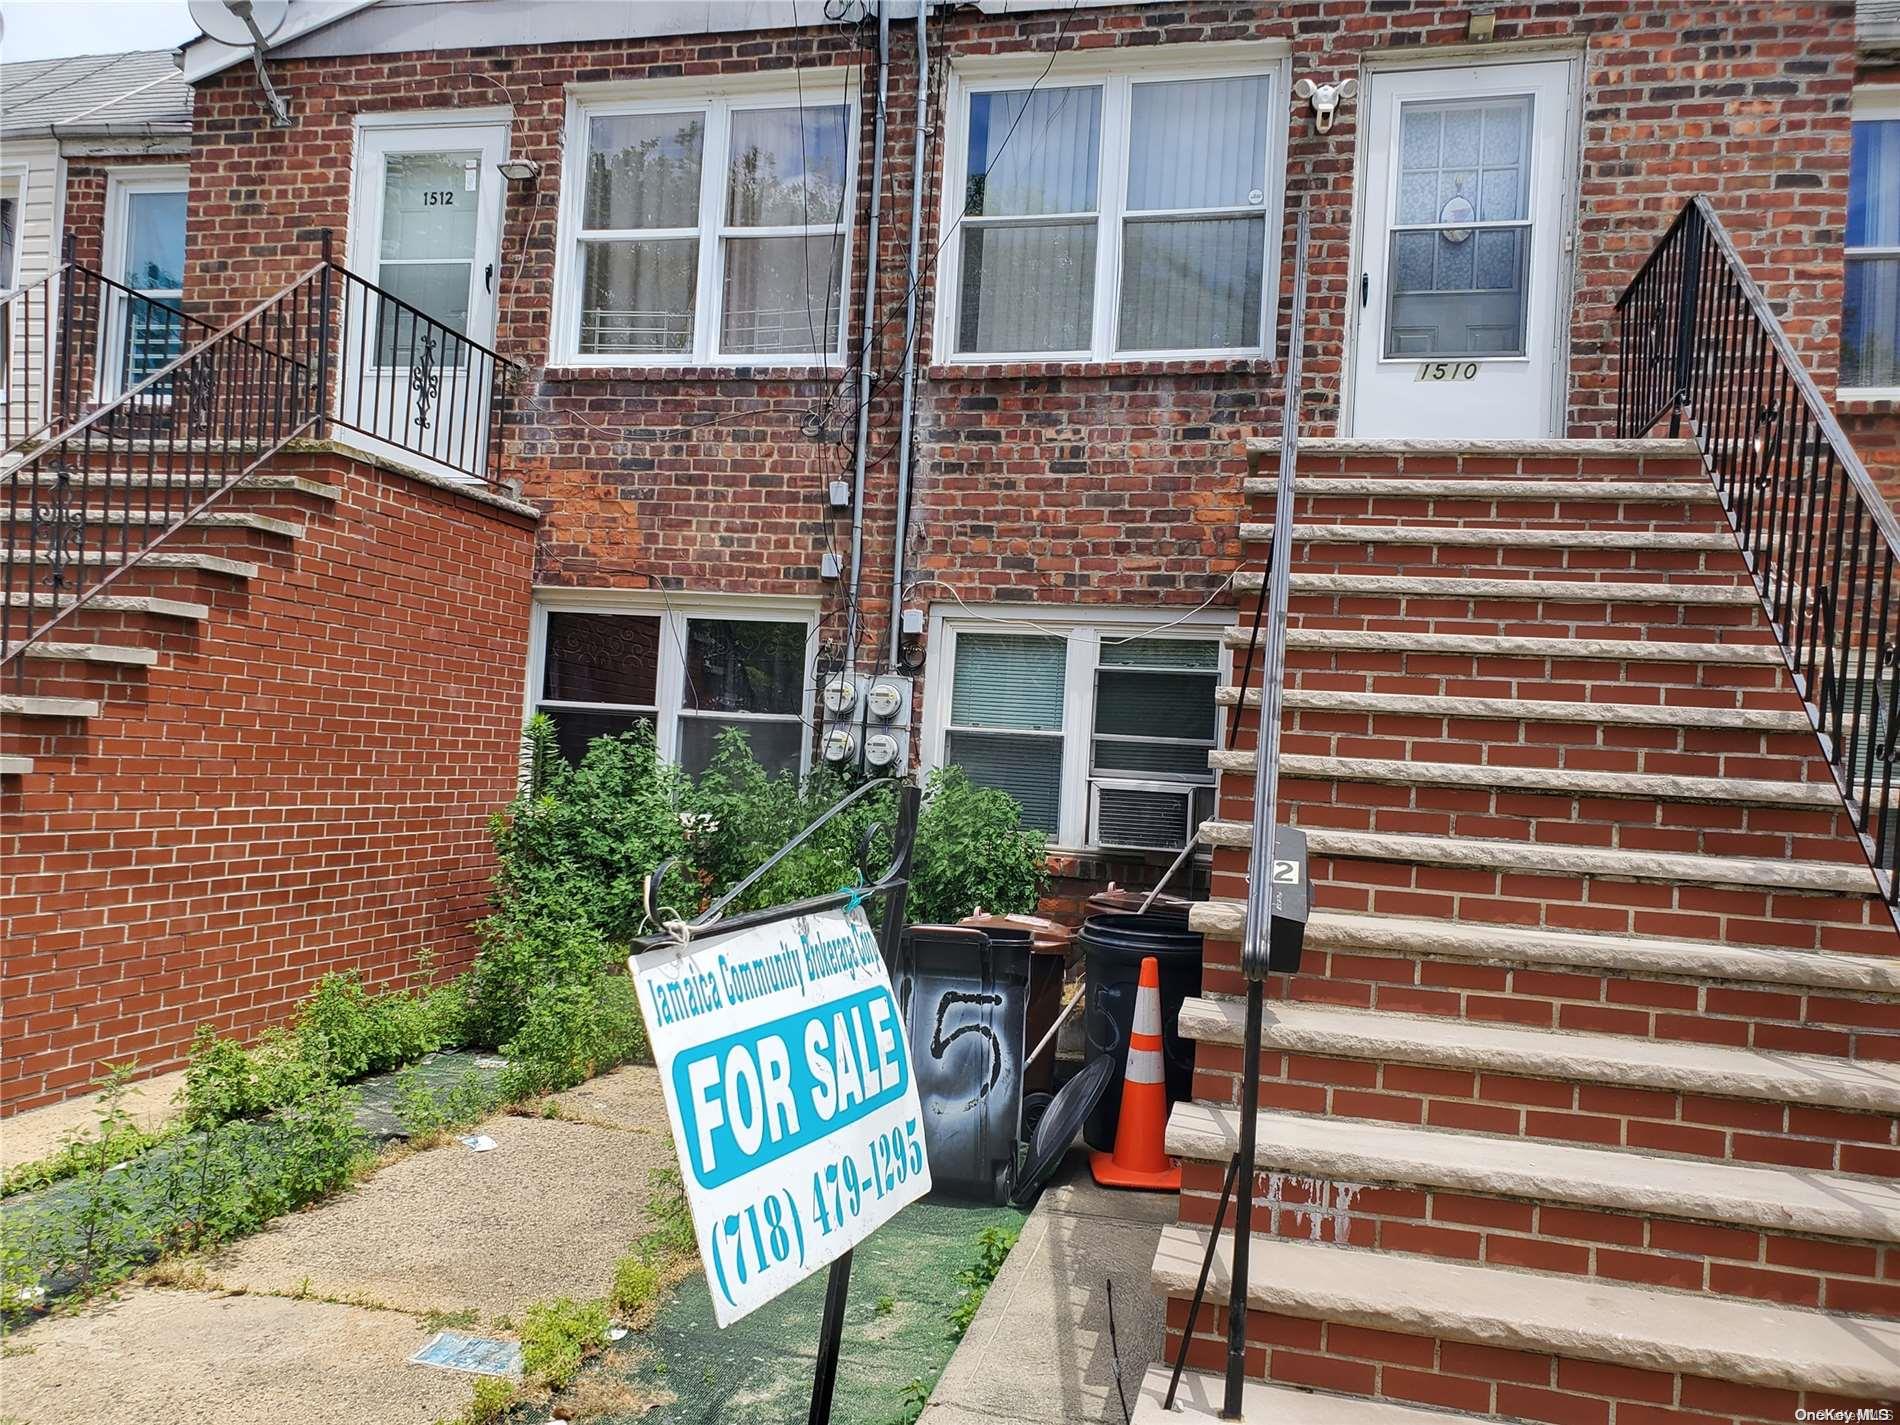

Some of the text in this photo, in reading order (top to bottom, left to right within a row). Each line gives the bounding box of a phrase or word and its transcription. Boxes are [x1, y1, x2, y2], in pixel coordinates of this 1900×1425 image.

[424, 192, 453, 206] 1512
[1421, 363, 1477, 380] 1510
[1274, 862, 1293, 881] 2
[647, 922, 881, 1027] Jamaica Community Brokerage Corp
[687, 1034, 800, 1175] FOR
[804, 997, 901, 1121] SALE
[711, 1117, 923, 1307] (718) 479-1295
